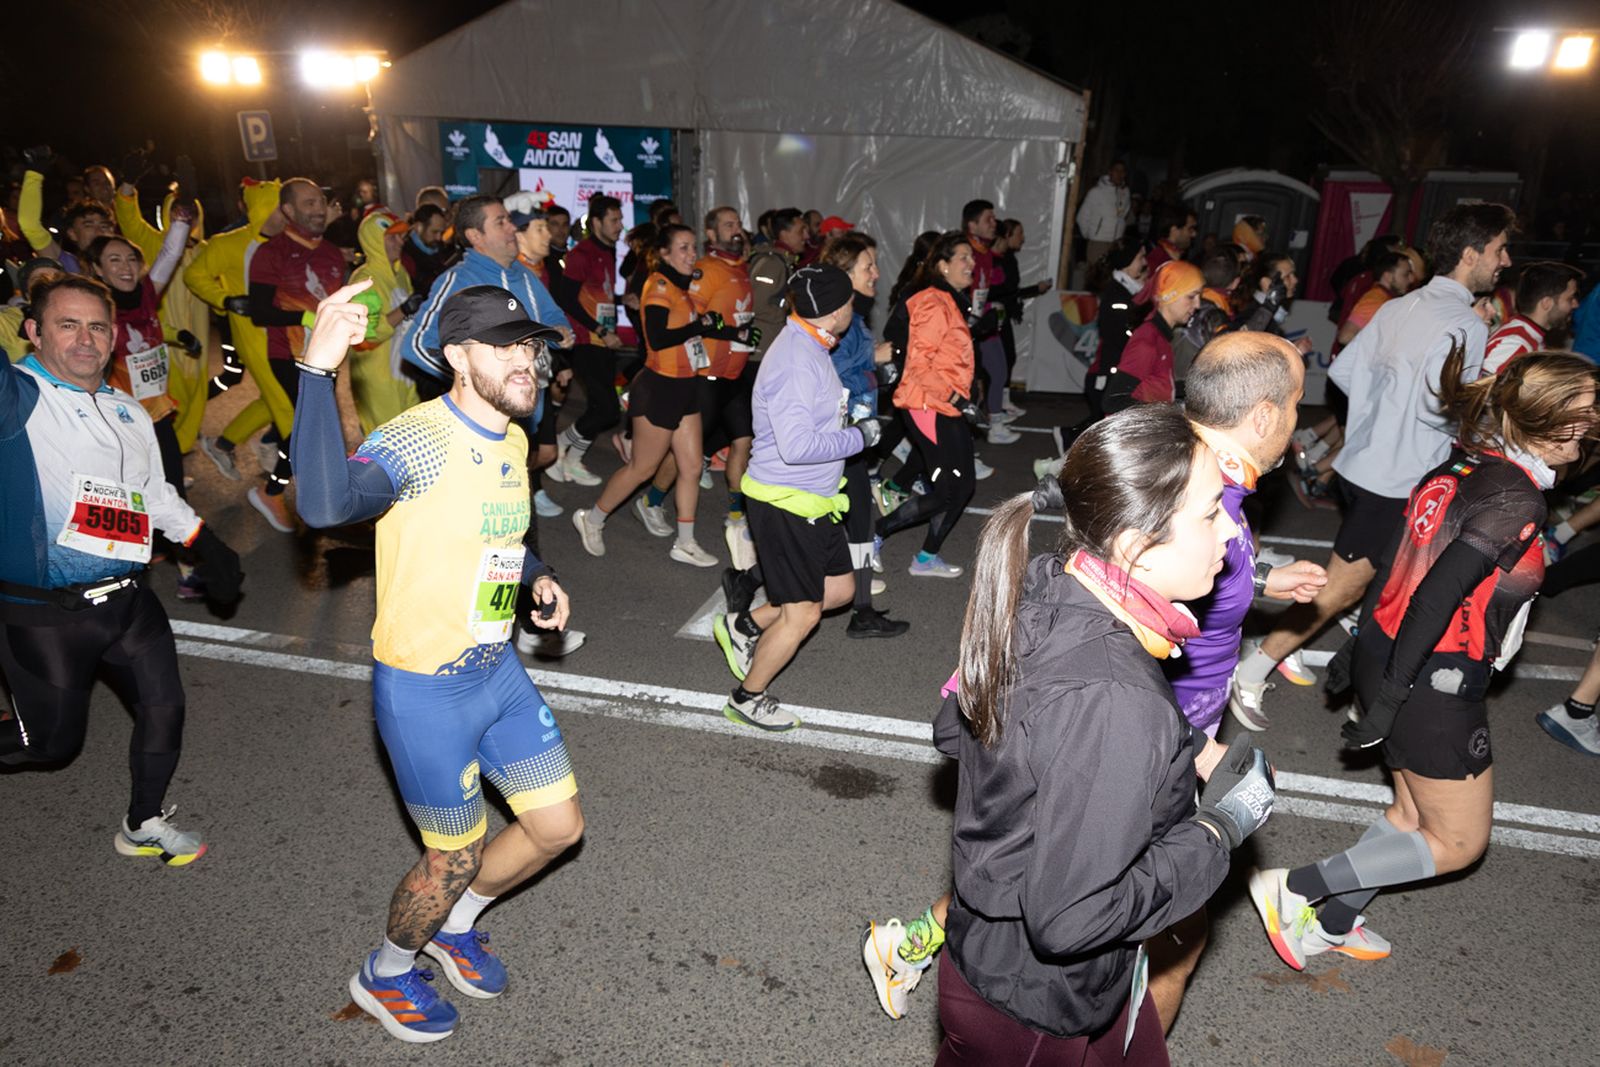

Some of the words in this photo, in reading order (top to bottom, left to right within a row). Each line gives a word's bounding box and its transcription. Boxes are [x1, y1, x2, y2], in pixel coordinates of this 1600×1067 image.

[247, 117, 267, 145] P
[547, 131, 582, 149] SAN
[523, 146, 580, 168] ANTÓN
[82, 494, 100, 504] SAN
[93, 487, 119, 497] NOCHE
[85, 505, 142, 536] 5965
[487, 571, 504, 581] SAN
[1246, 783, 1271, 804] SAN
